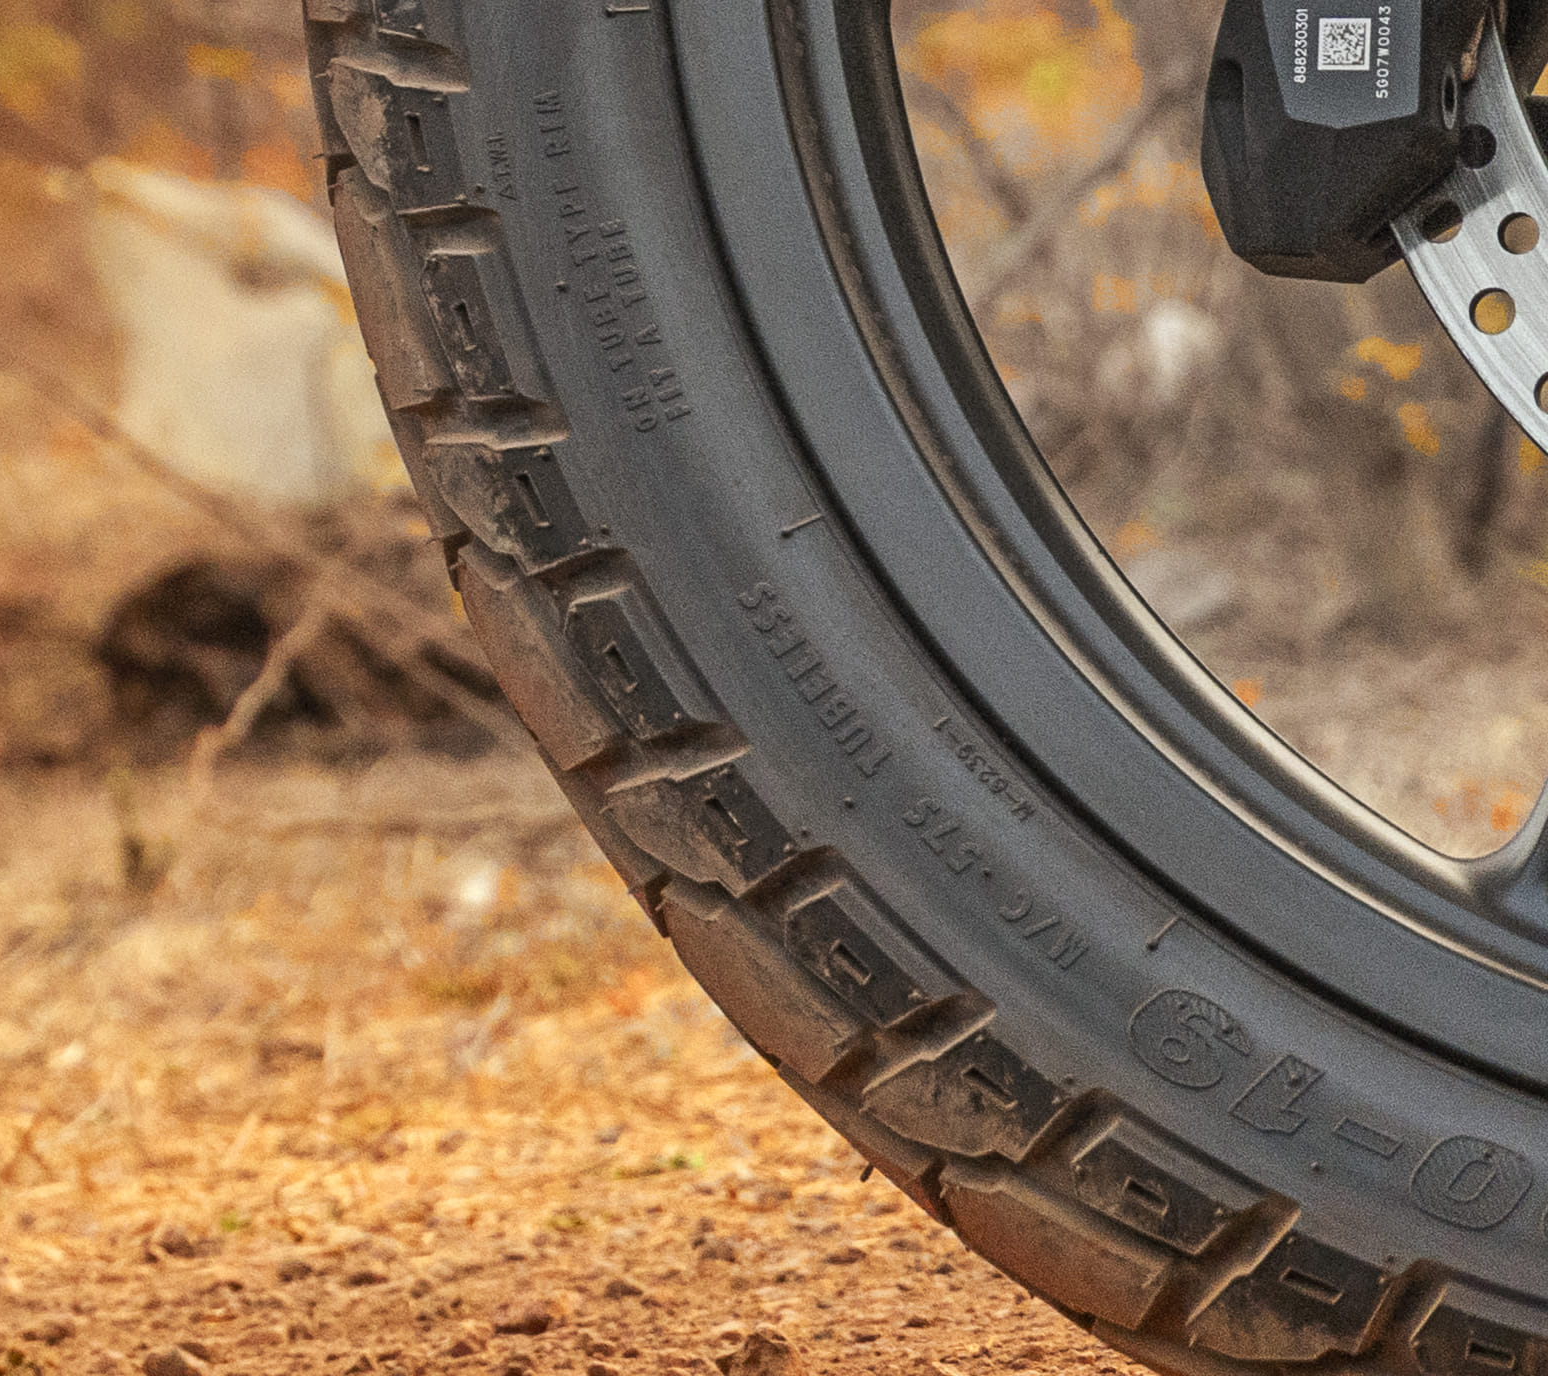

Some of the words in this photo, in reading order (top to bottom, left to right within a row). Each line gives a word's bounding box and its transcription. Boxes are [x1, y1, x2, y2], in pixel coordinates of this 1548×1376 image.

[555, 184, 598, 268] TYPE
[599, 218, 647, 309] TUBE
[583, 287, 634, 373] TUBE
[728, 575, 898, 782] TUBELESS
[1129, 989, 1548, 1233] 0-19
